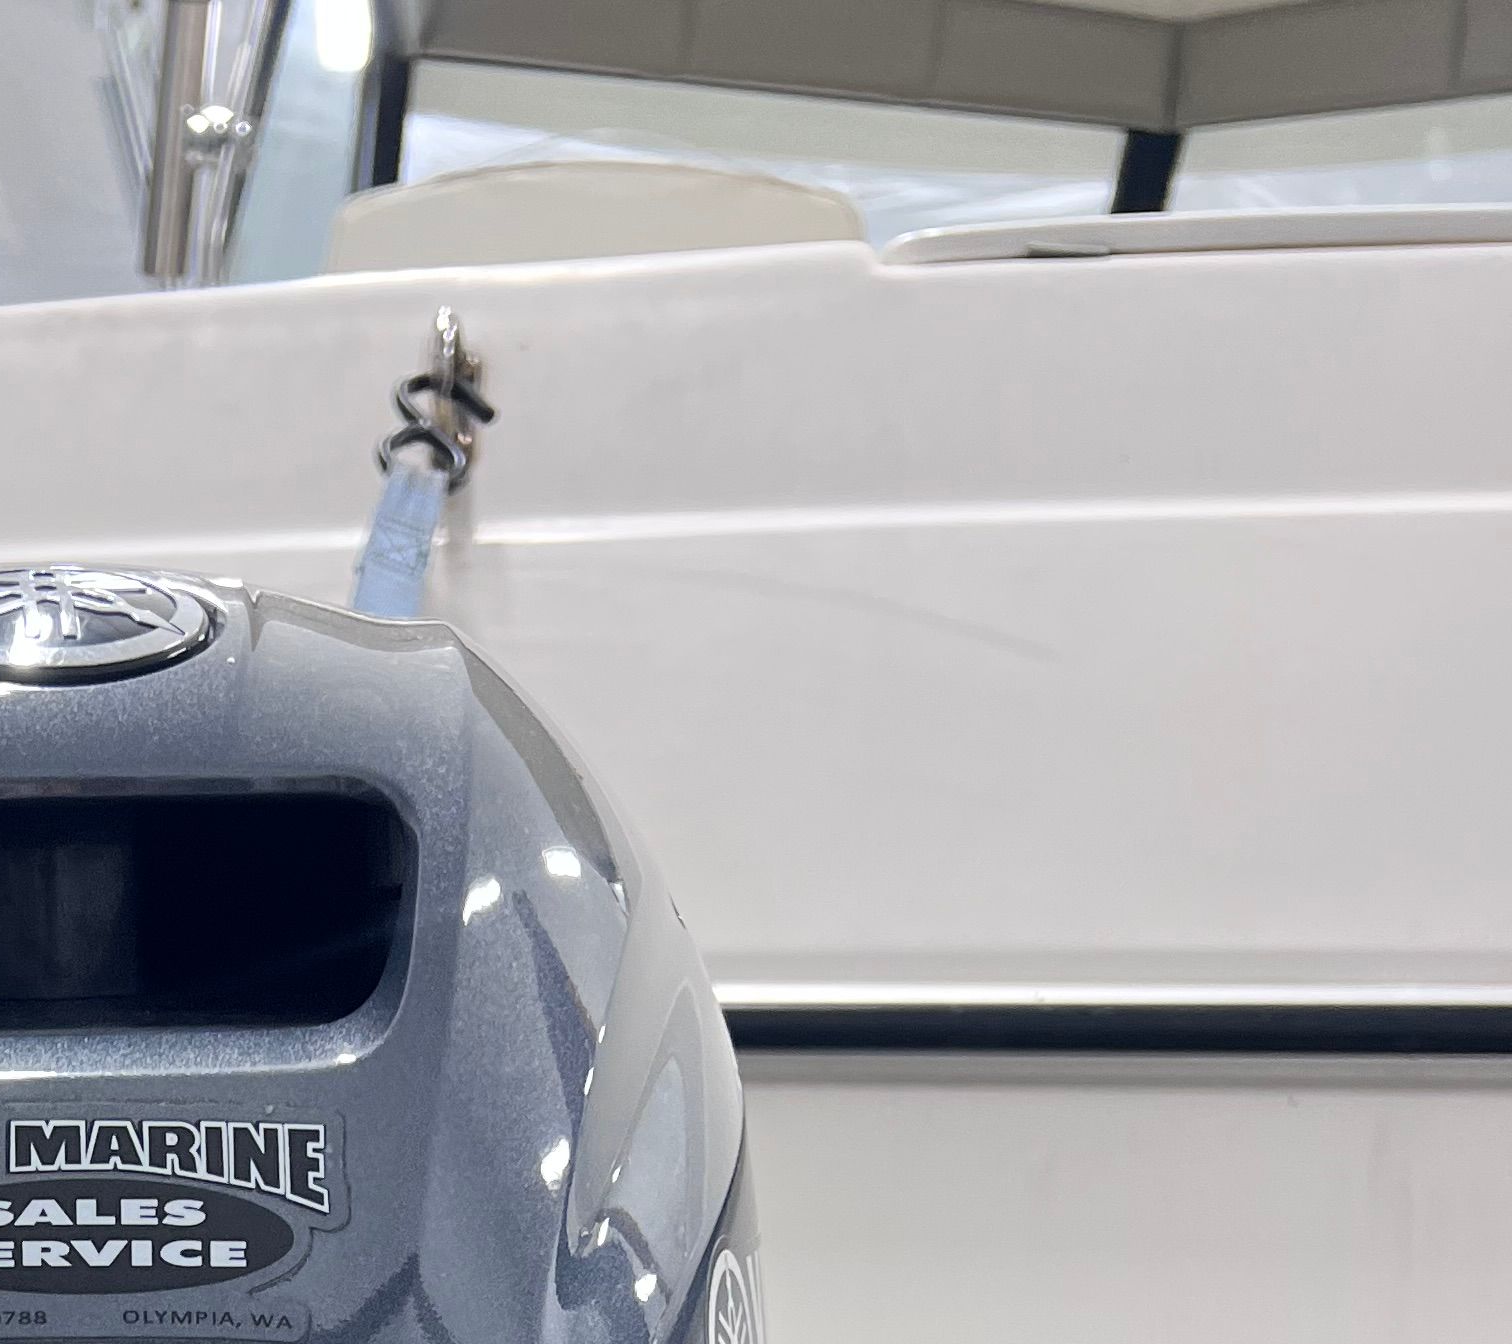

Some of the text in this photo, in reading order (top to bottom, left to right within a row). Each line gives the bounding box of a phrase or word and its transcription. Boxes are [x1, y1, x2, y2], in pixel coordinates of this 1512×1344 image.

[8, 1119, 330, 1214] MARINE
[121, 1309, 243, 1329] OLYMPIA,
[250, 1313, 294, 1330] WA
